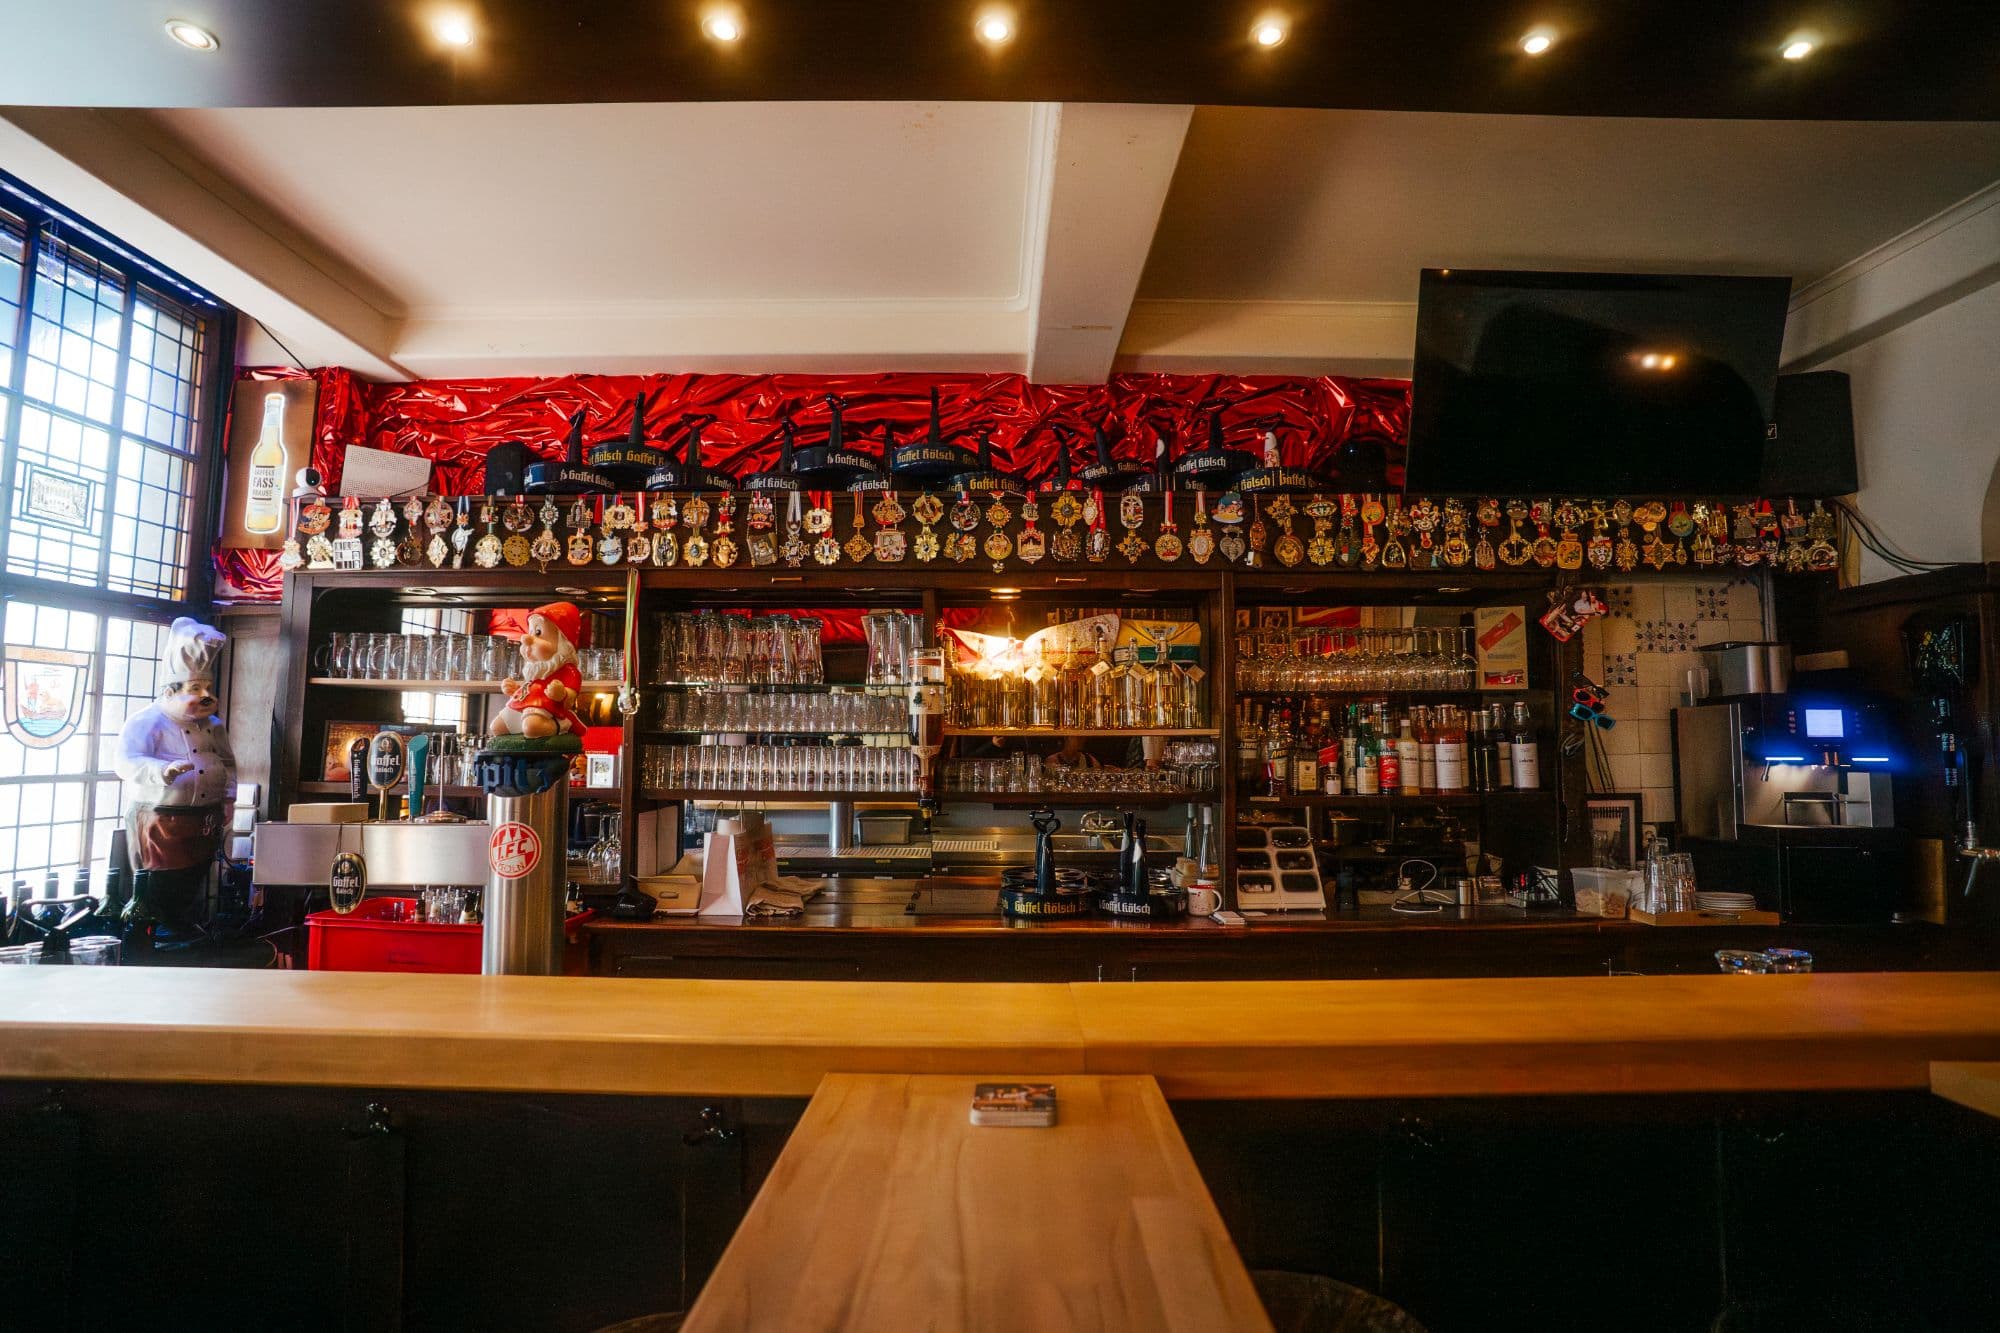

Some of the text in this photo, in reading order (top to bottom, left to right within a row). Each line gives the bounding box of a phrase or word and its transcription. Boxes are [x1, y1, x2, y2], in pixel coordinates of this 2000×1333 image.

[626, 450, 656, 465] Gaffel
[835, 453, 858, 467] Gaffel
[897, 451, 920, 463] Gaffel
[922, 448, 955, 461] Kölsch
[1198, 456, 1227, 469] Kölsch
[568, 469, 595, 482] Gaffel
[253, 477, 274, 489] FASS
[767, 477, 798, 490] Kölsch
[862, 480, 889, 491] Kölsch
[969, 478, 998, 491] Gaffel
[1240, 475, 1271, 492] Kölsch
[333, 876, 362, 888] Gaffel
[1014, 901, 1041, 915] Gaffel
[1043, 902, 1077, 914] Kölsch
[1122, 901, 1151, 915] Kölsch
